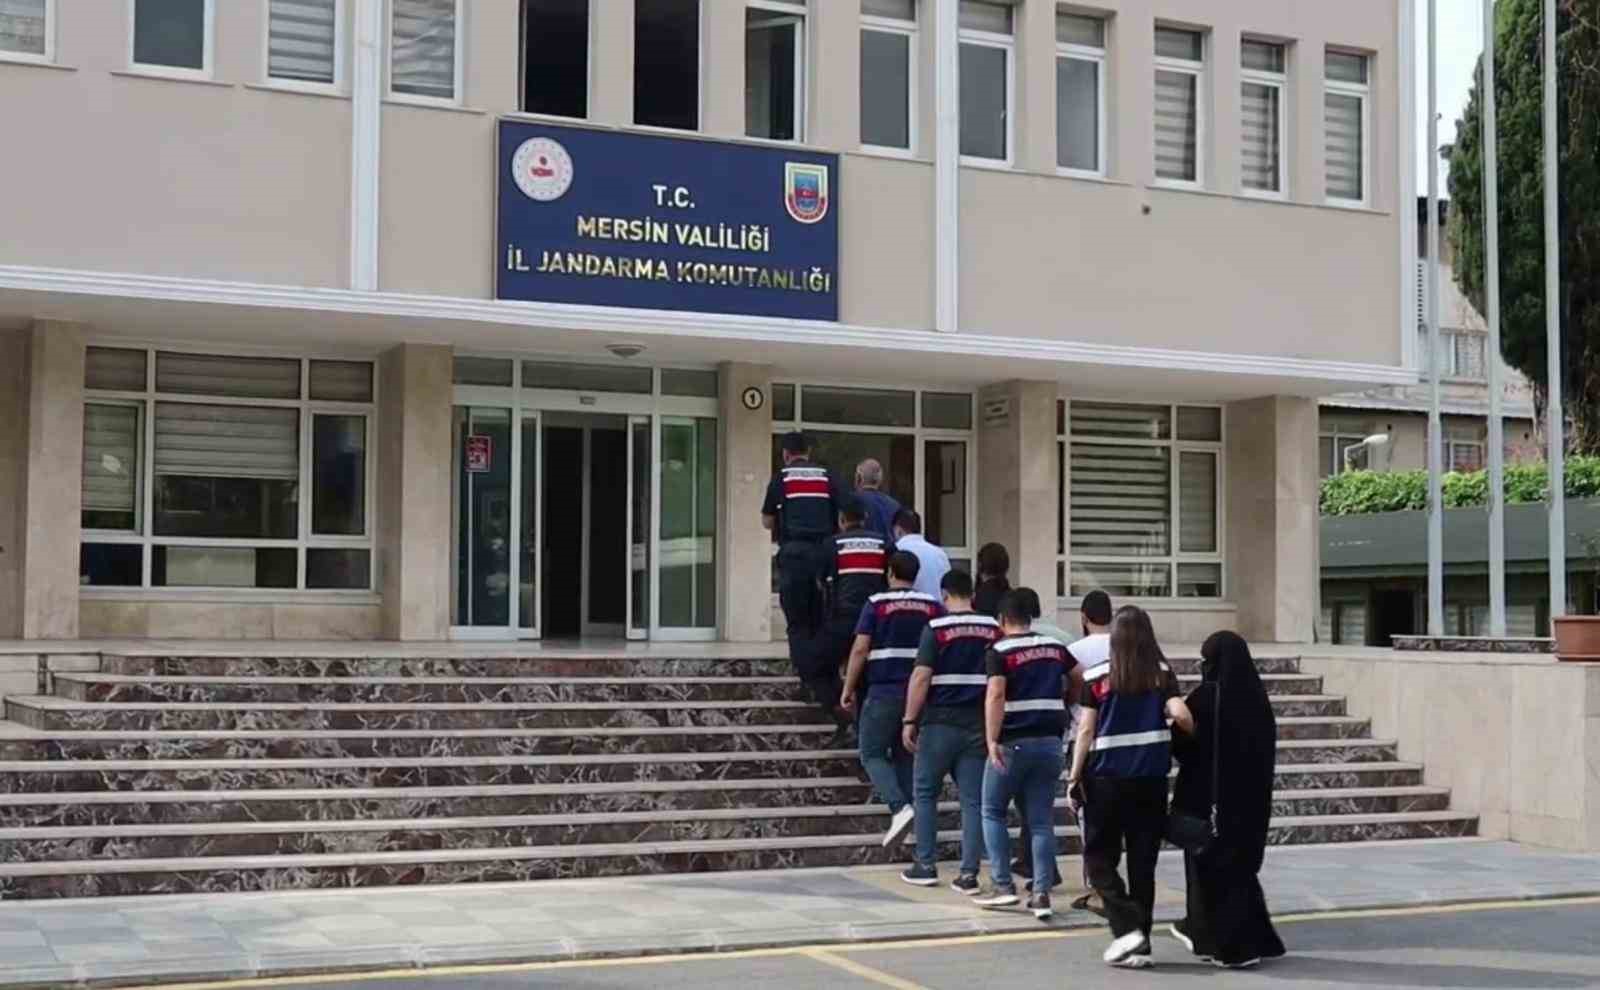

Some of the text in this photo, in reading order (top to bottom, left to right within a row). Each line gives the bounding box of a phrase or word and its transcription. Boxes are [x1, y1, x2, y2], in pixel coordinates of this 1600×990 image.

[652, 184, 695, 208] T.C.
[576, 214, 769, 252] MERSİN VALİLİĞİ
[507, 243, 831, 293] İL JANDARMA KOMUTANLIĞI
